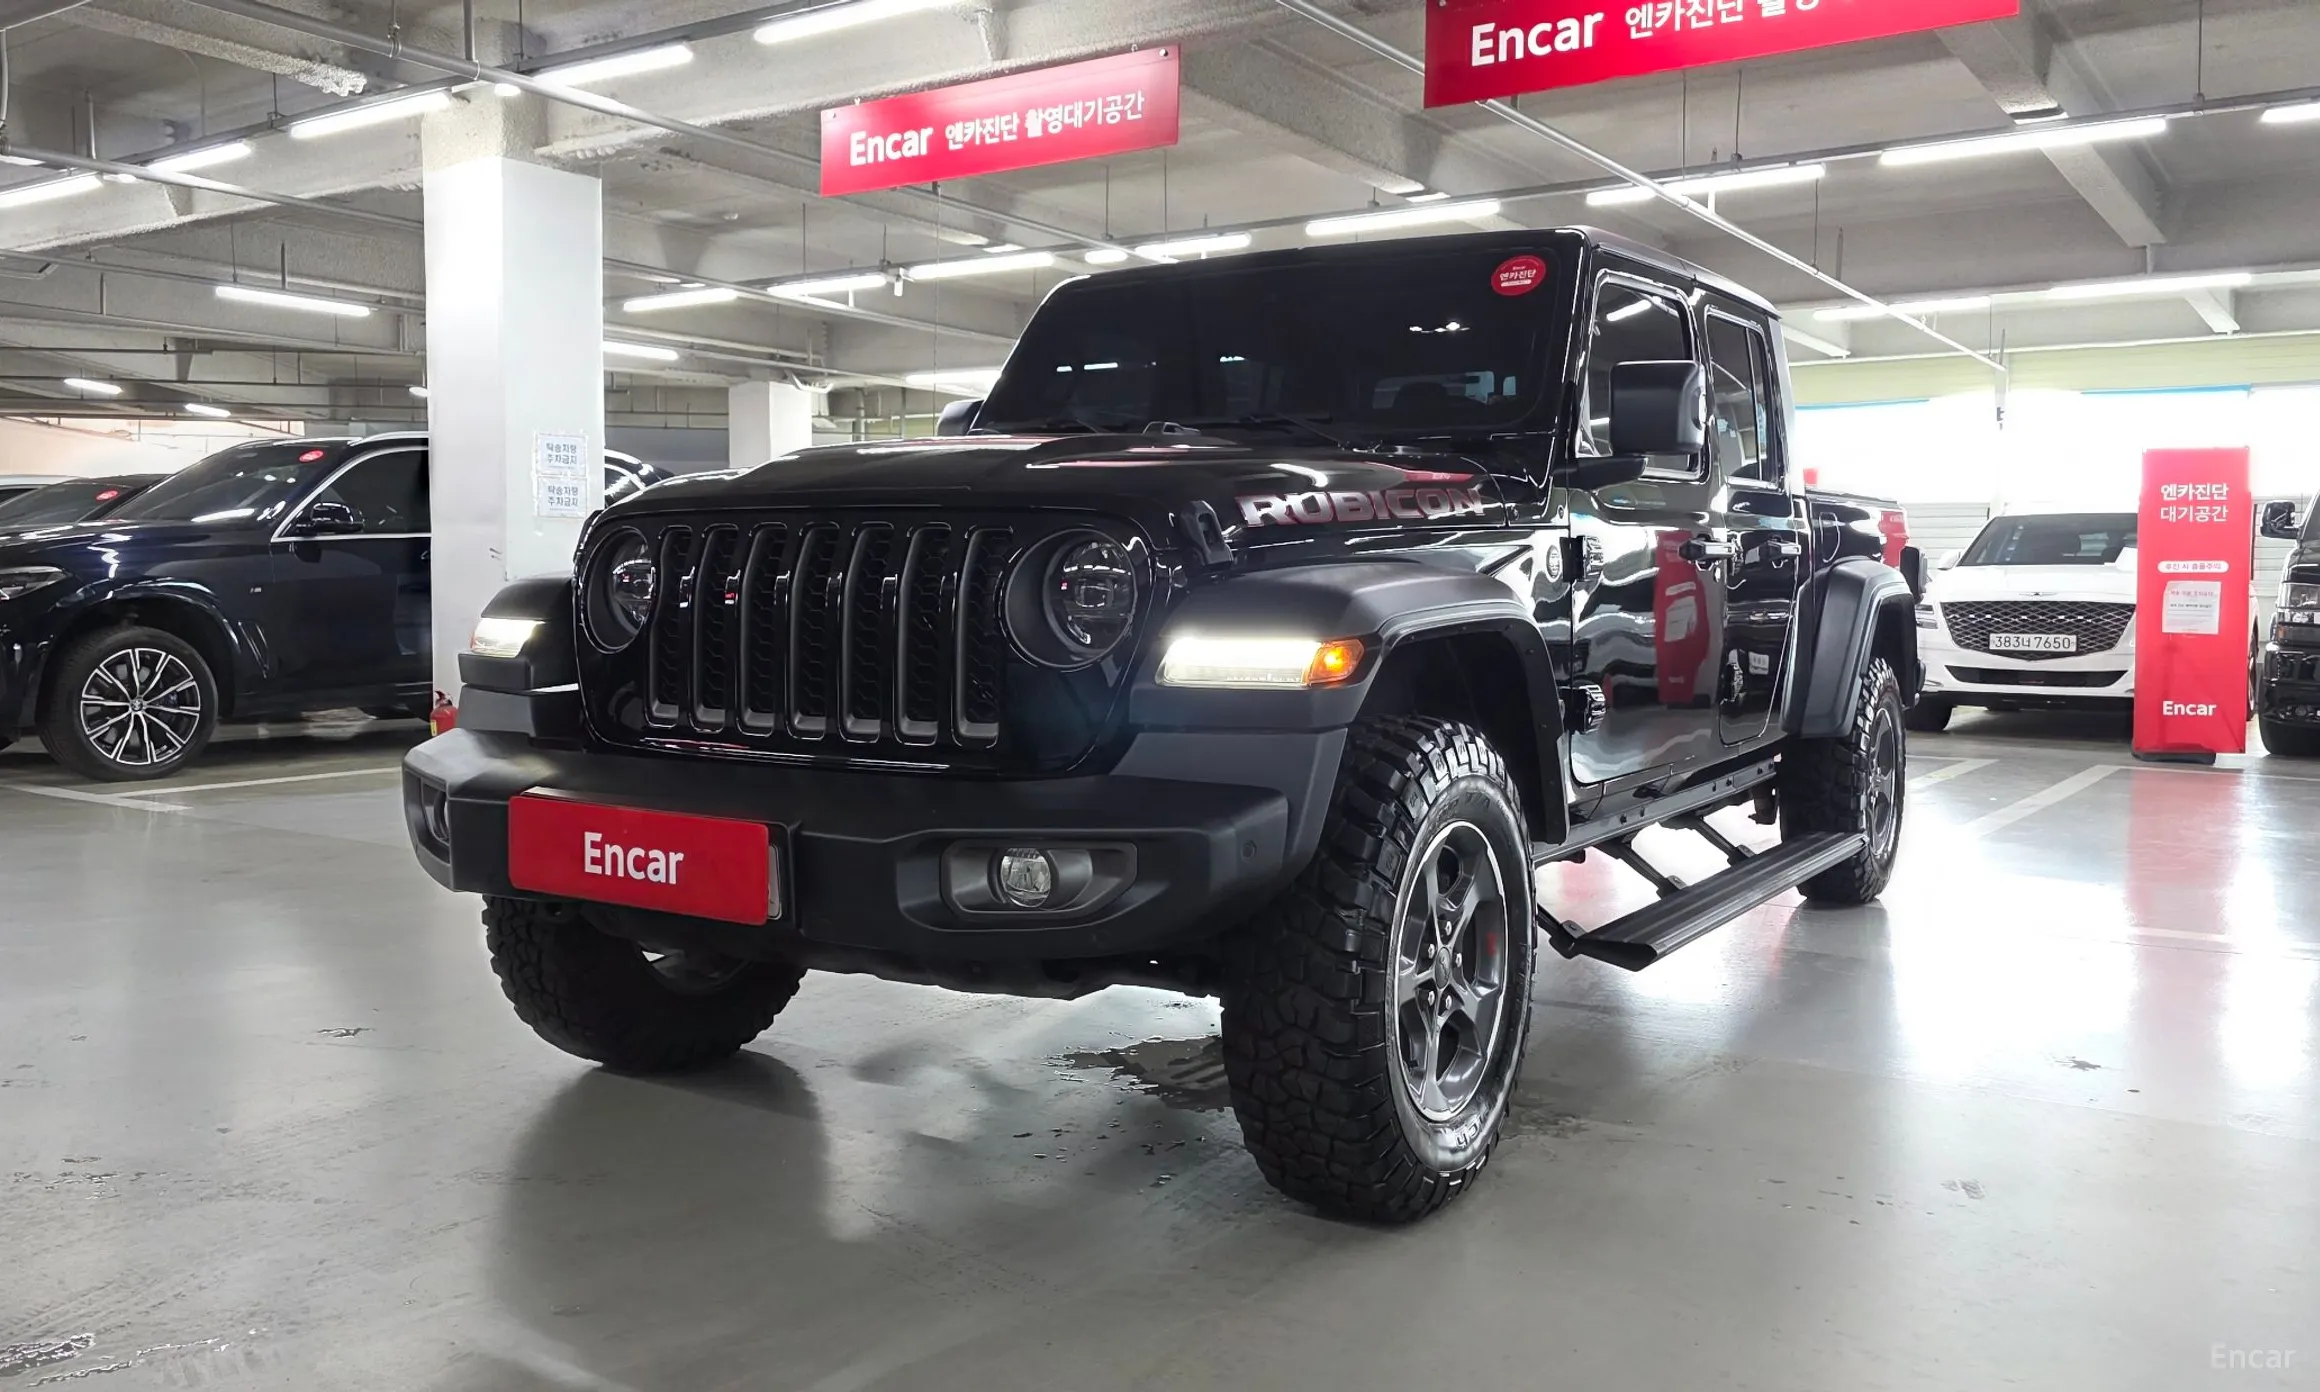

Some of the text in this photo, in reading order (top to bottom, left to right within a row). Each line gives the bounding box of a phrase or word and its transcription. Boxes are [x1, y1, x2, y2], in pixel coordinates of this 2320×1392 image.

[1471, 12, 1605, 67] Encar
[849, 126, 934, 167] Encar
[945, 111, 1021, 151] 엔카진단
[2160, 483, 2229, 501] 엔카진단
[1235, 488, 1485, 528] RUBICON
[2160, 505, 2229, 522] 대기공간
[2034, 636, 2071, 649] 7650
[2162, 700, 2217, 717] Encar
[584, 831, 685, 885] Encar
